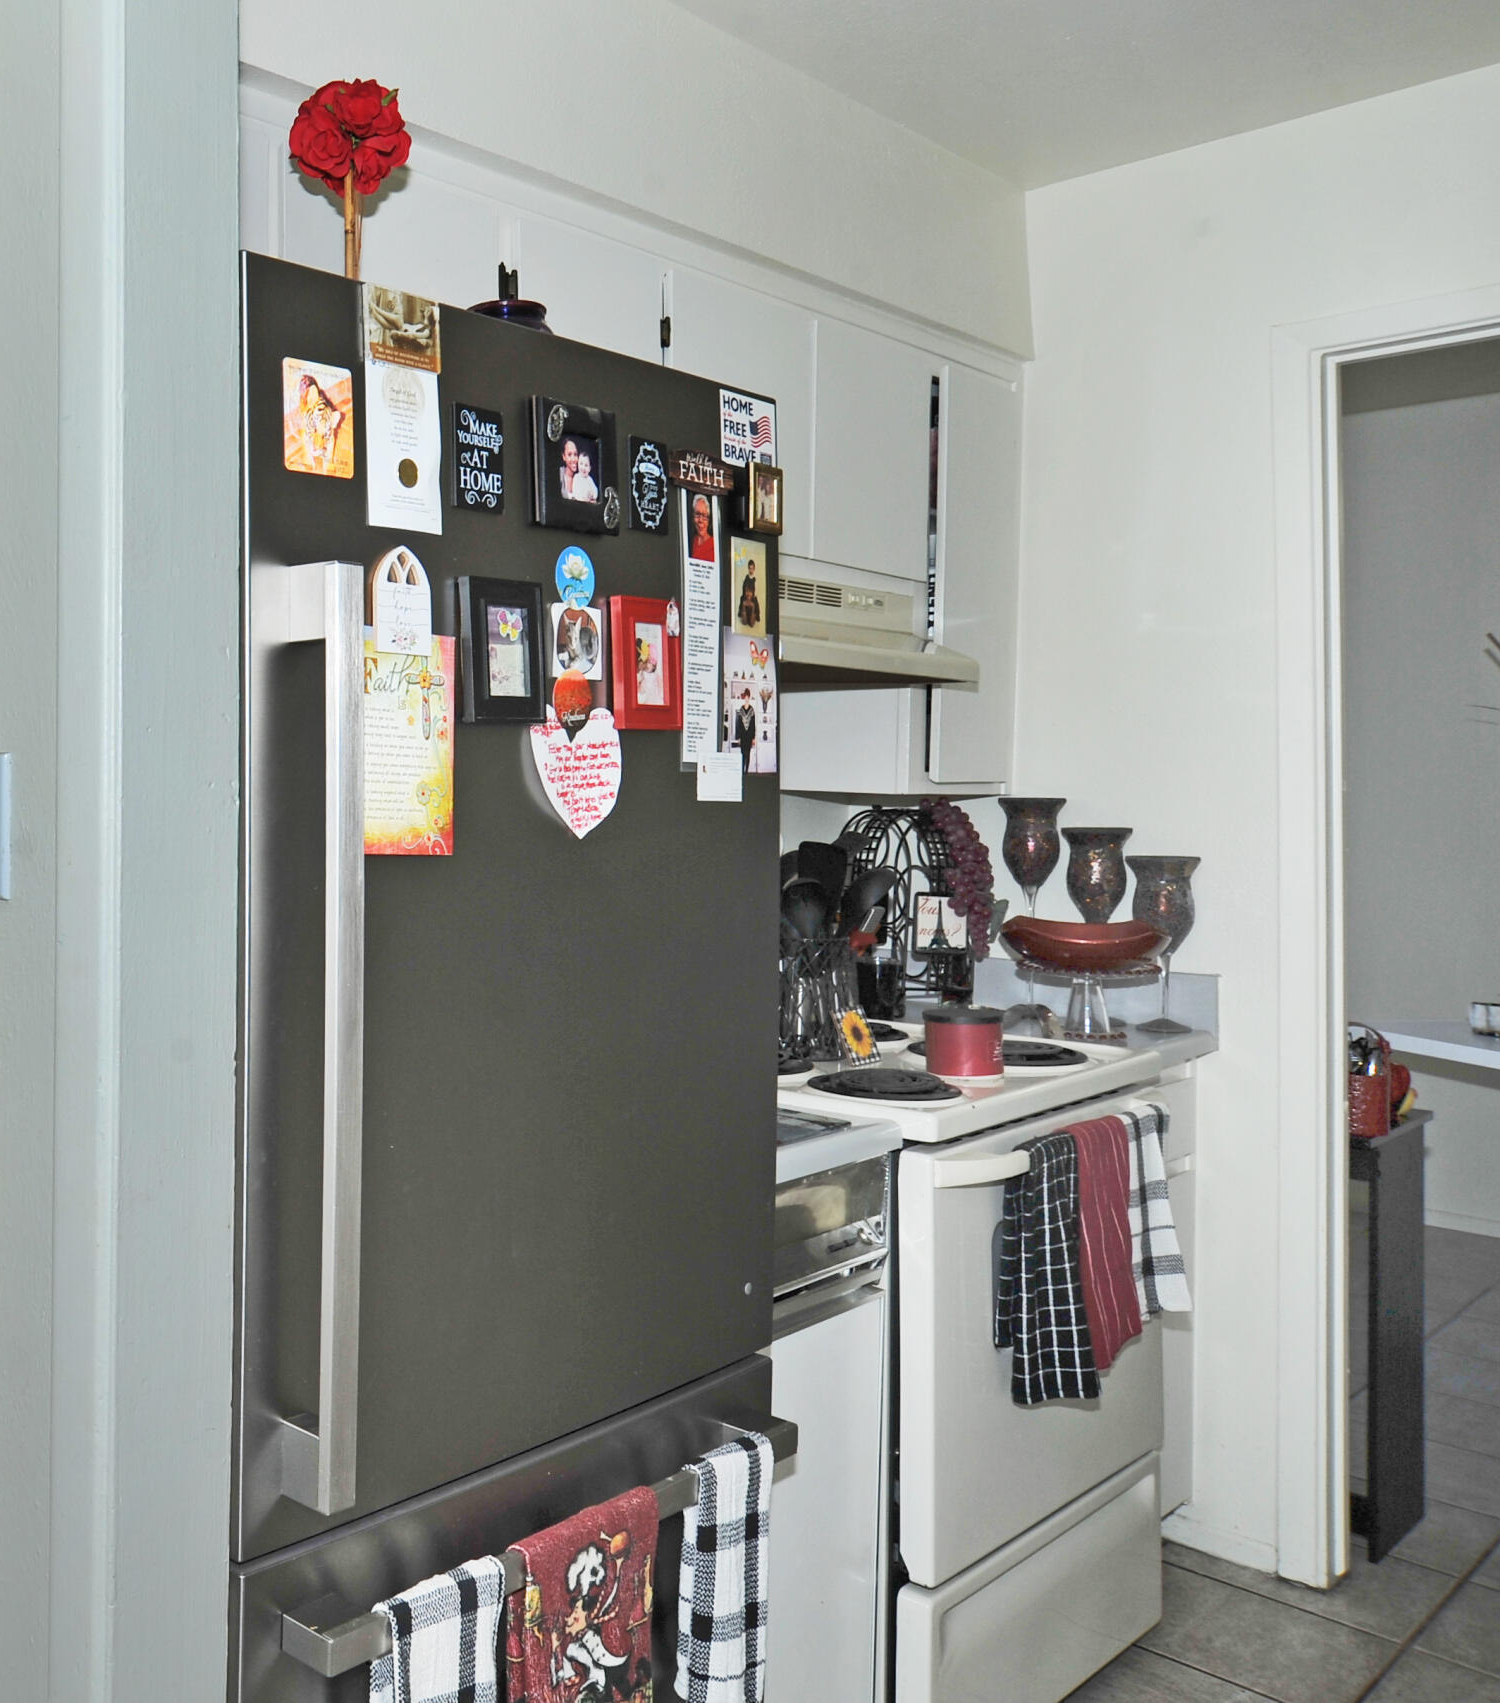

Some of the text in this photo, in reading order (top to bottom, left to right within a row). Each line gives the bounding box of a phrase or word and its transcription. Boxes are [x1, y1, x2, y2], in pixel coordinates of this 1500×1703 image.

[723, 394, 754, 416] HOME
[467, 416, 498, 438] MAKE
[723, 418, 747, 438] FREE
[457, 430, 499, 449] YOURSELF
[469, 448, 489, 469] AT
[460, 466, 503, 494] HOME
[679, 460, 725, 488] FAITH
[364, 654, 415, 695] Faith
